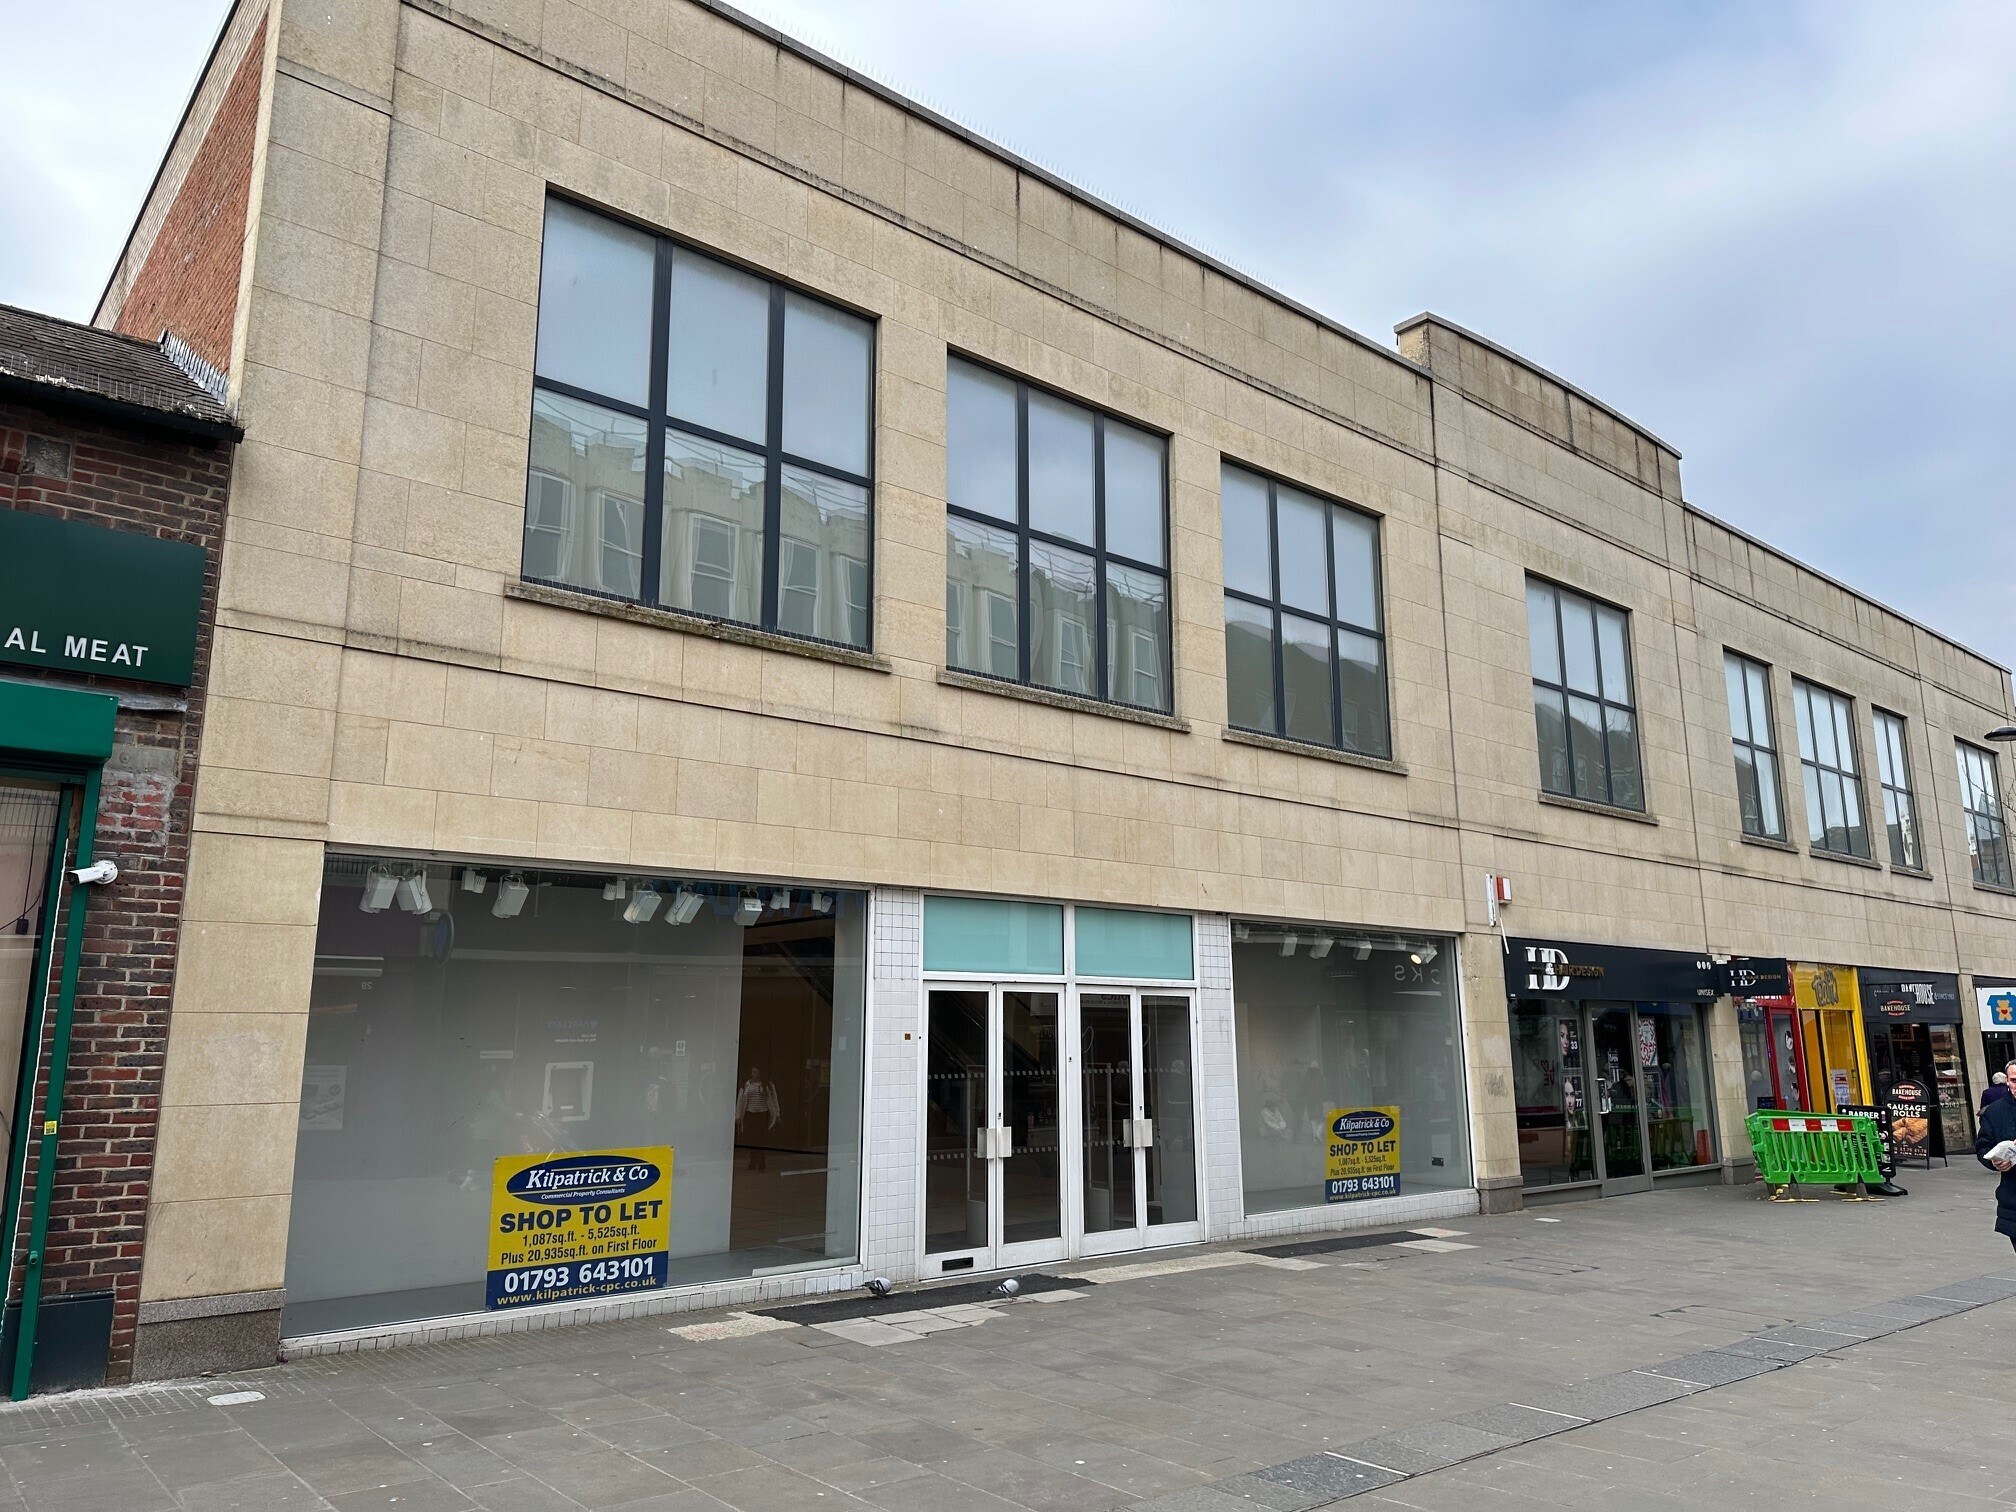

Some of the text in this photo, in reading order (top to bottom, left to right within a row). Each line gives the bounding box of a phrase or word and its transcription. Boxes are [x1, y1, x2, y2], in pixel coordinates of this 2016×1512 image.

[4, 627, 149, 667] AL MEAT
[1880, 1004, 1911, 1012] BAKEHOUSE
[1892, 1088, 1922, 1096] BAKEHOUSE
[1849, 1111, 1879, 1119] BARBER
[1887, 1103, 1927, 1112] SAUSAGE
[1893, 1110, 1920, 1118] ROLLS
[1340, 1118, 1390, 1131] Kilpatrick & Co
[1330, 1140, 1396, 1157] SHOP TO LET
[526, 1166, 648, 1190] Kilpatrick & Co
[1332, 1176, 1394, 1193] 01793 643101
[541, 1192, 573, 1200] Commercial
[573, 1190, 595, 1198] Property
[500, 1200, 662, 1233] SHOP TO LET
[523, 1230, 577, 1247] 1,087sq.ft.
[588, 1224, 640, 1241] 5,525sq.ft.
[501, 1237, 657, 1265] Plus 20,935sq.ft. on First Floor
[504, 1257, 653, 1293] 01793 643101
[497, 1276, 656, 1305] www.kilpatrick-cpc.co.uk
